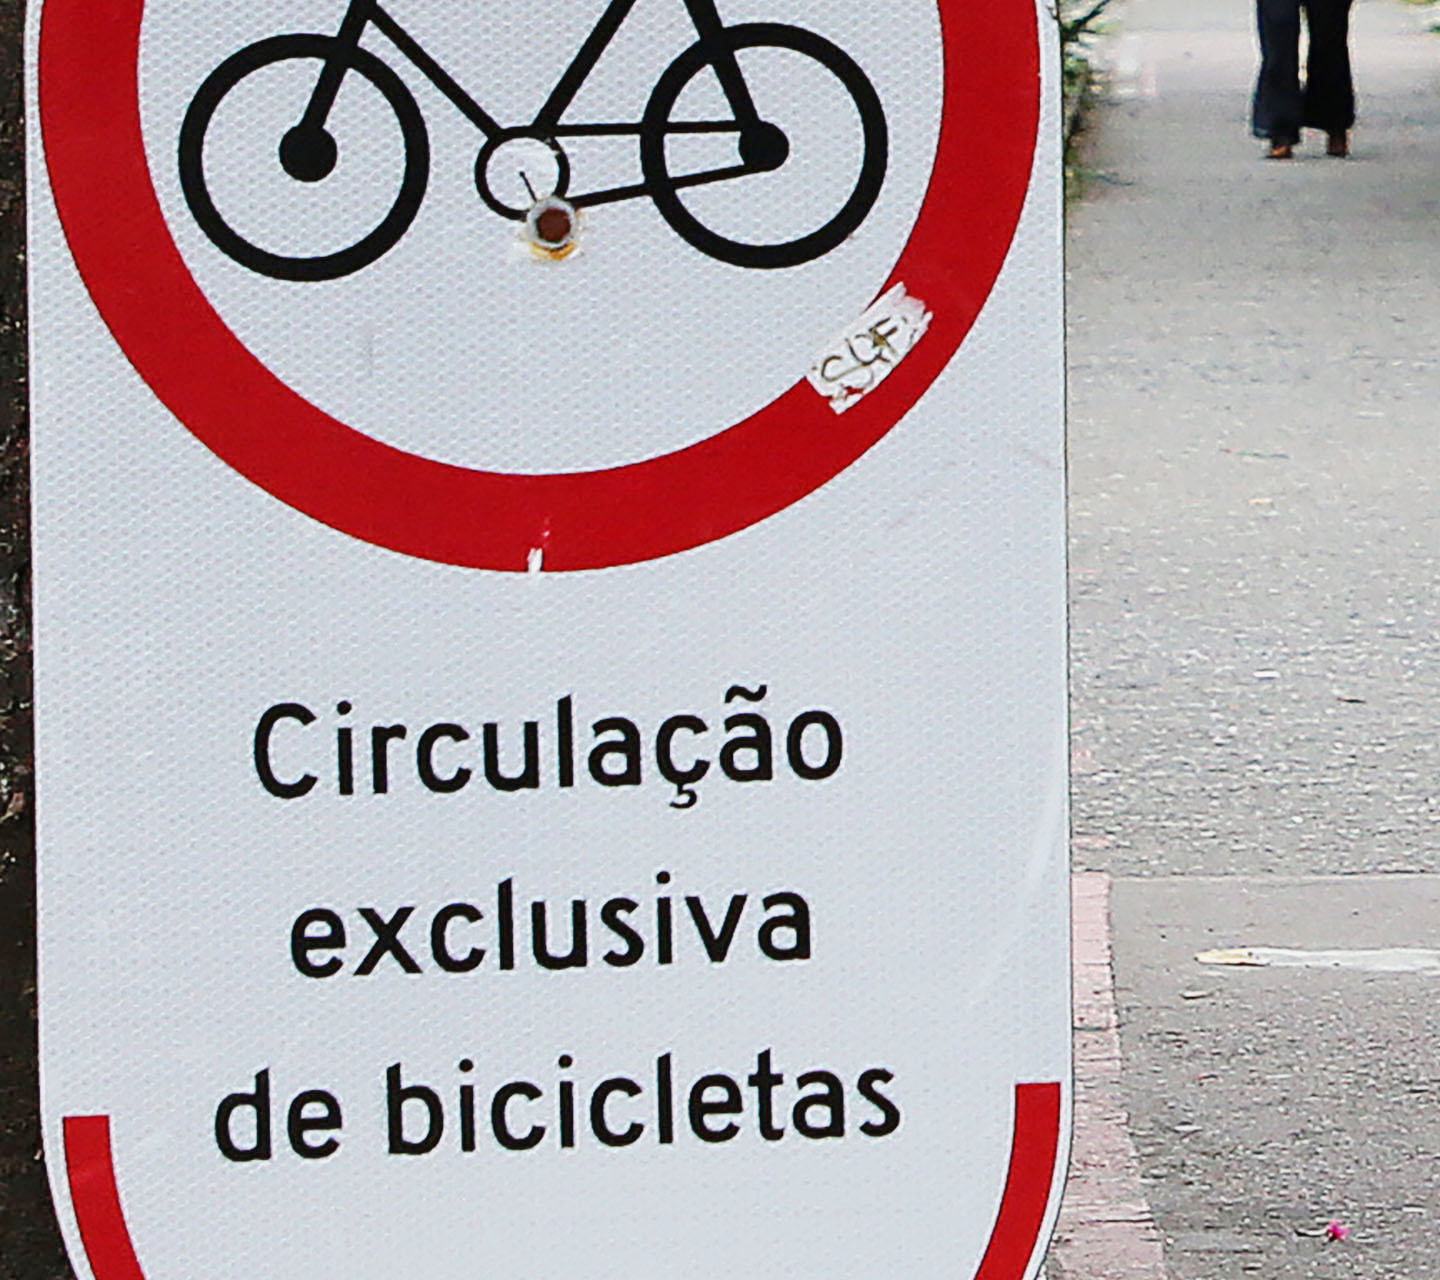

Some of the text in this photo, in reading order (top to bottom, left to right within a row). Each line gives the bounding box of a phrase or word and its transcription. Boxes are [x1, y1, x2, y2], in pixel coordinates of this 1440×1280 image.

[253, 683, 843, 809] Circulação
[290, 870, 812, 979] exclusiva
[214, 1048, 902, 1162] de bicicletas
